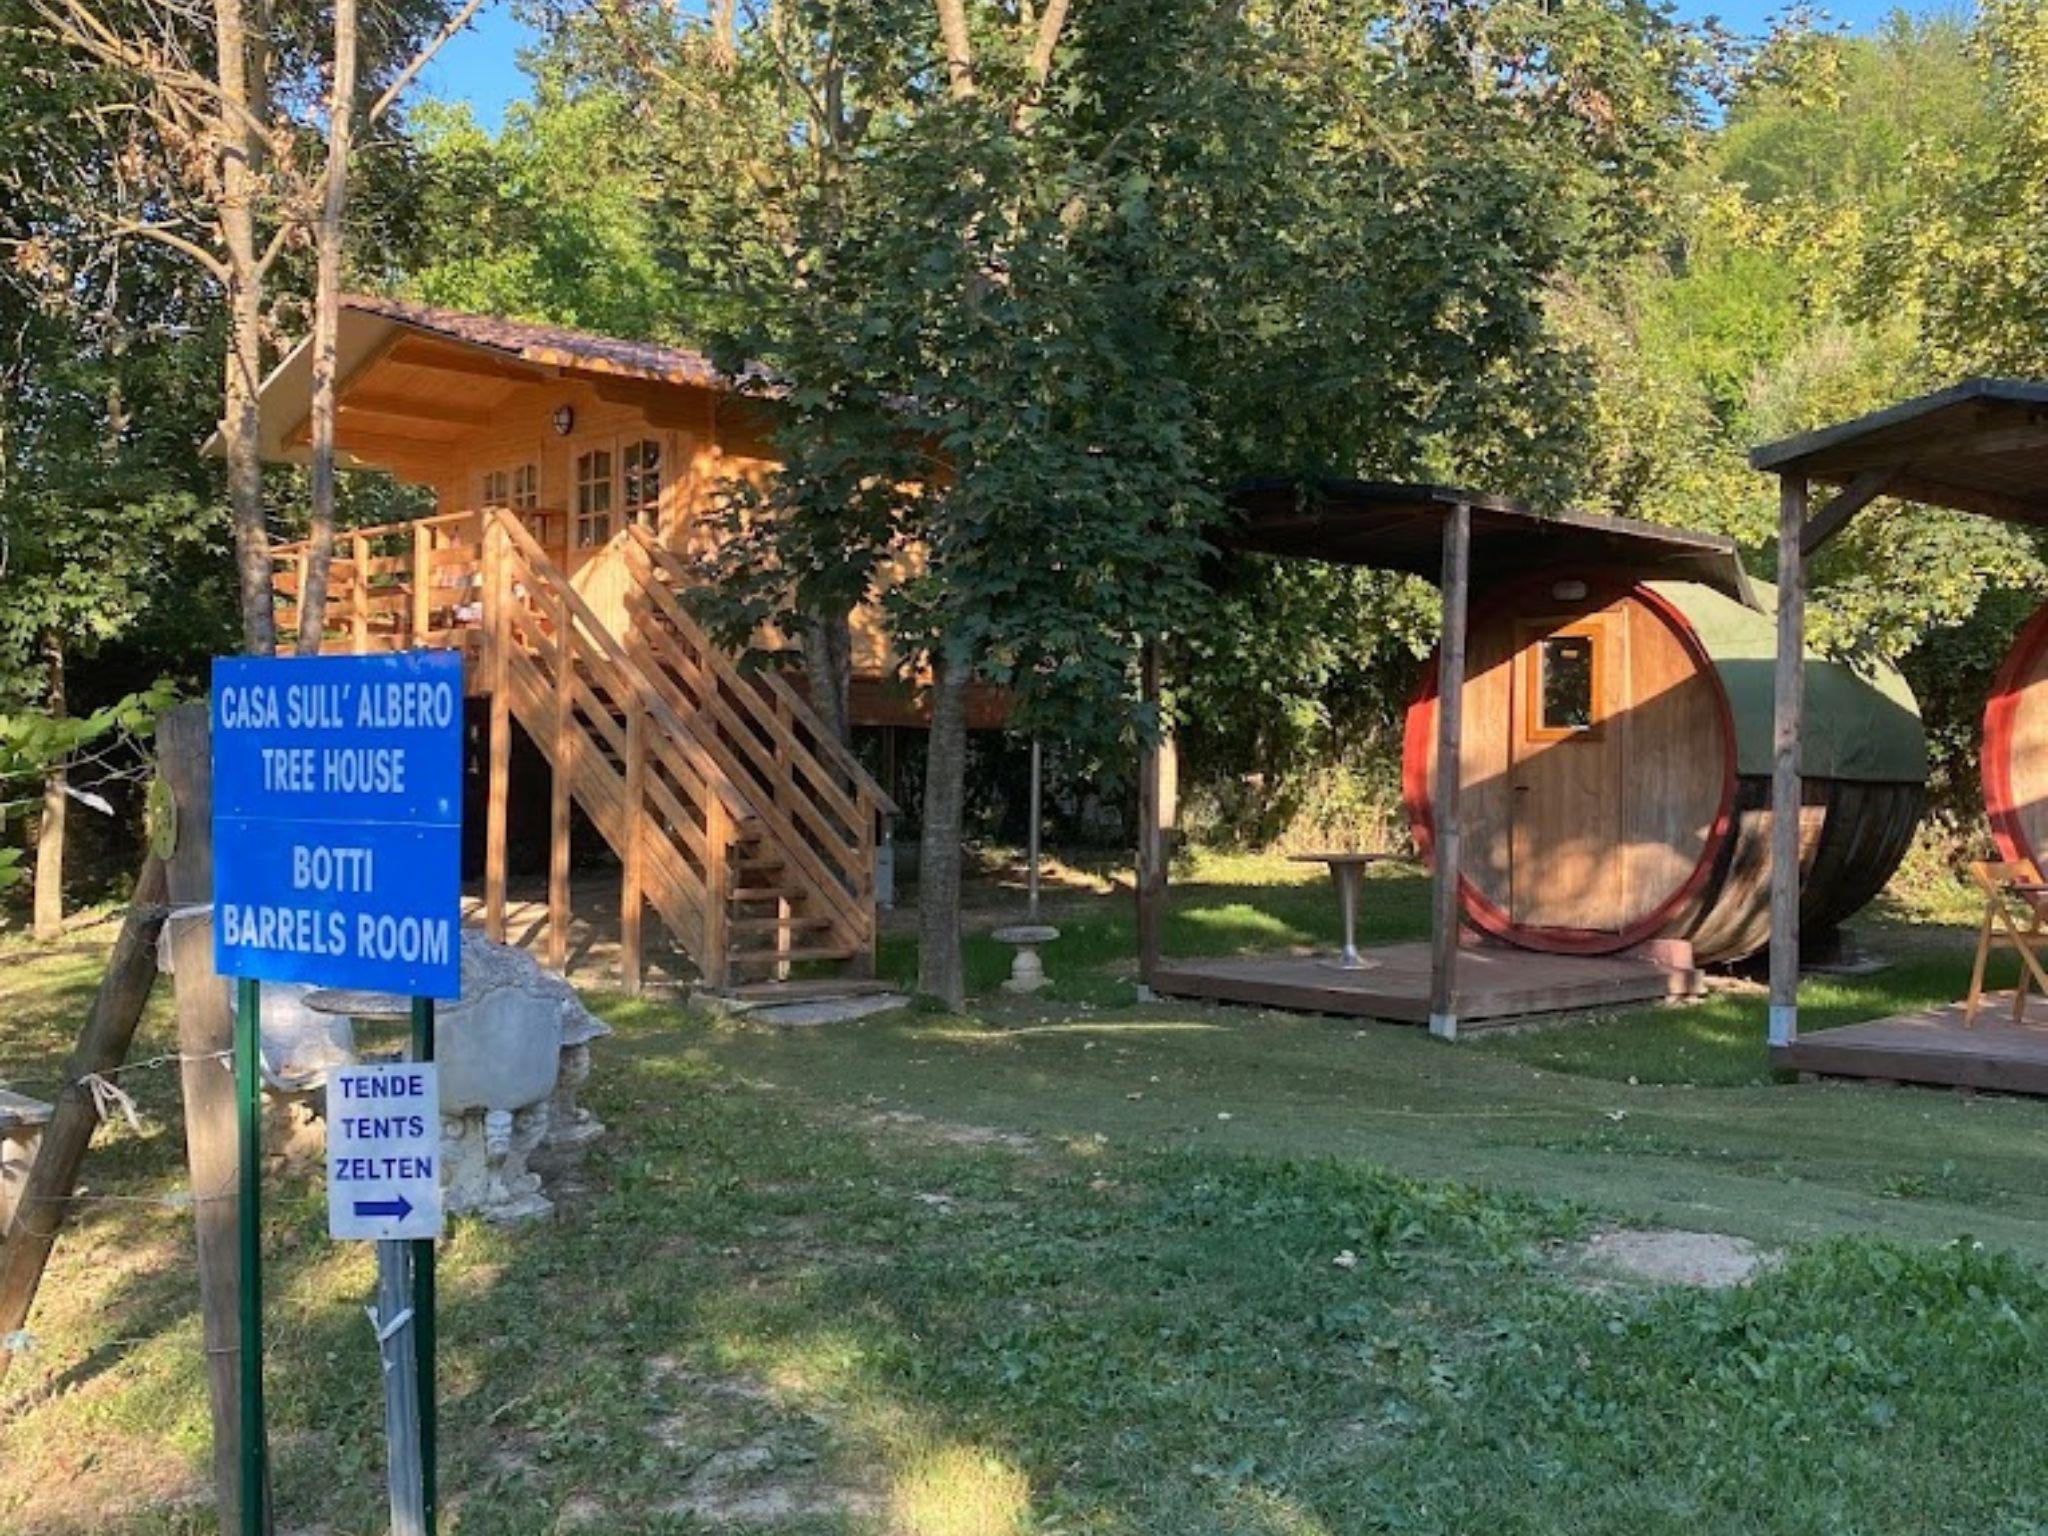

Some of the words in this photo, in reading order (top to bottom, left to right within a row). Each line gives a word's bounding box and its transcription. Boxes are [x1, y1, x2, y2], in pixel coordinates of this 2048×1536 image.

[221, 685, 280, 729] CASA
[287, 684, 351, 729] SULL'
[357, 682, 453, 728] ALBERO
[262, 749, 315, 791] TREE
[323, 749, 405, 793] HOUSE
[293, 846, 373, 892] BOTTI
[223, 904, 346, 956] BARRELS
[358, 913, 449, 965] ROOM
[340, 1075, 424, 1098] TENDE
[342, 1116, 424, 1139] TENTS
[336, 1157, 432, 1180] ZELTEN
